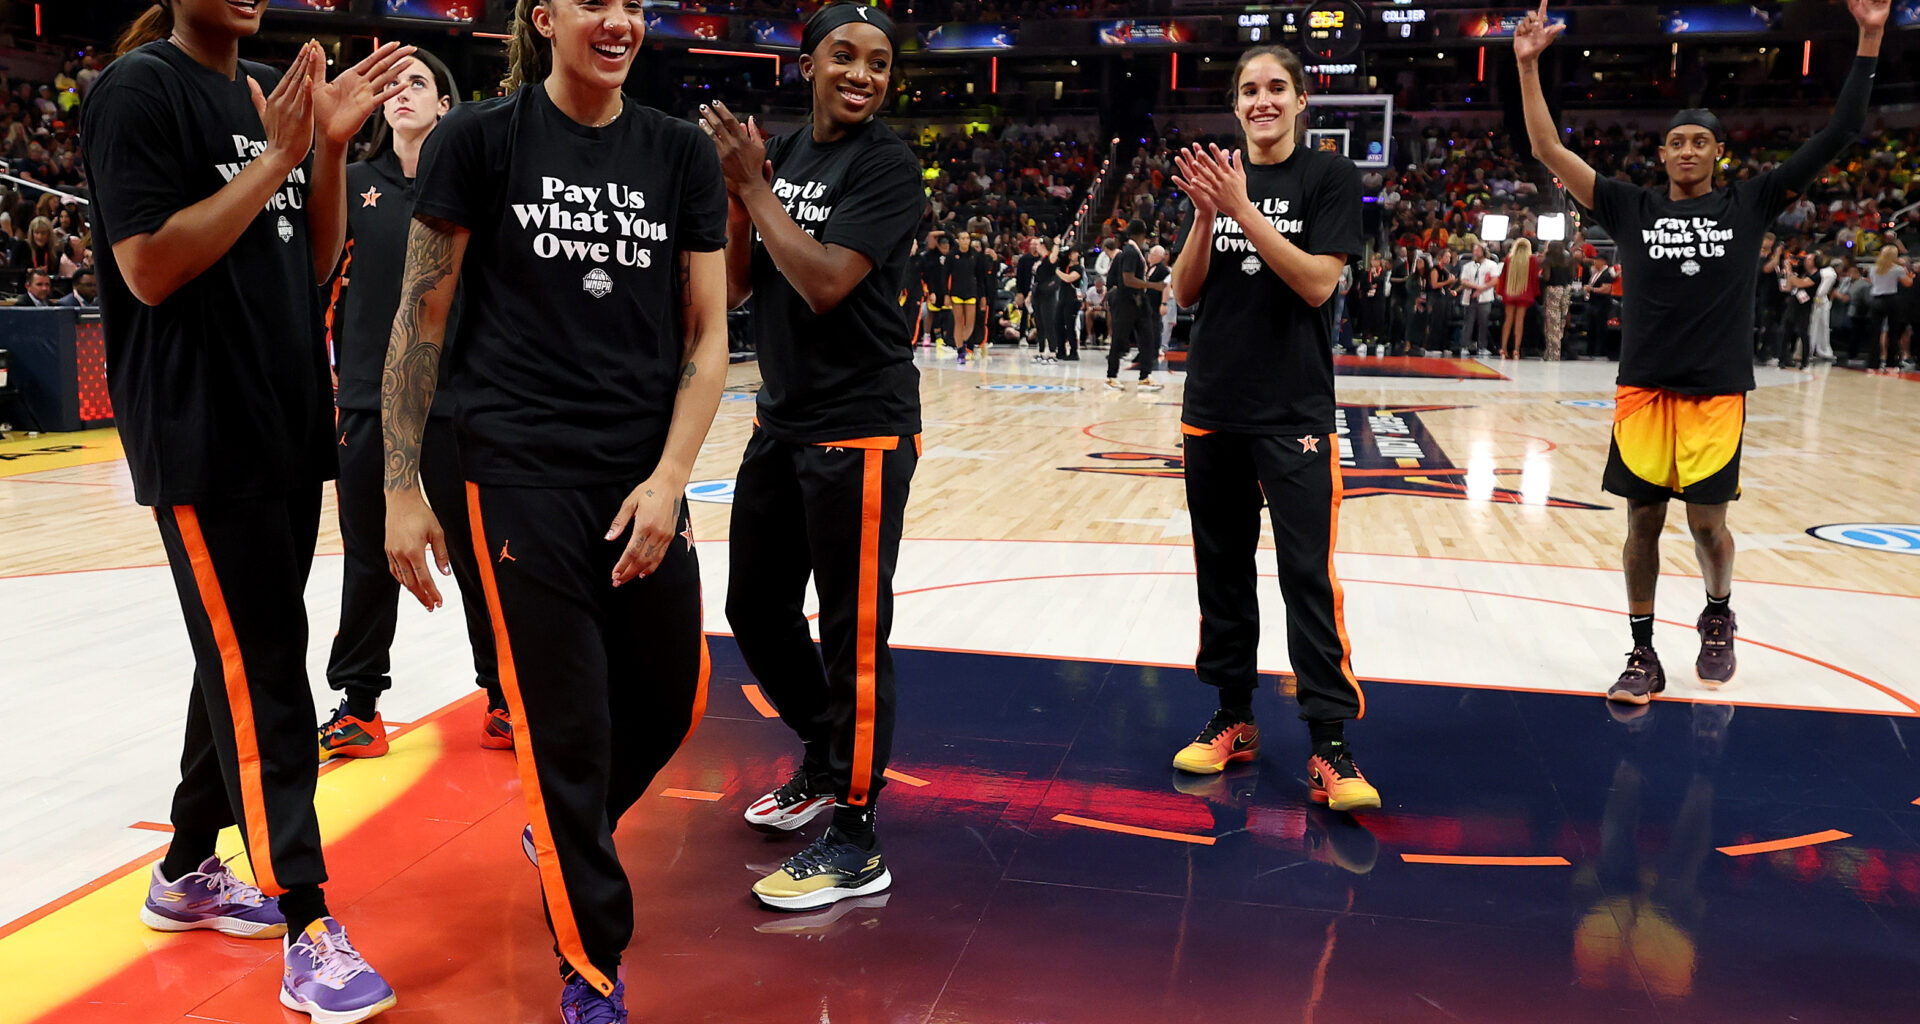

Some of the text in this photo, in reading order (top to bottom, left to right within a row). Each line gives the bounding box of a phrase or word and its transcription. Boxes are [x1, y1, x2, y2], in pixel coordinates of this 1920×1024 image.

[1238, 14, 1269, 27] CLARK
[1382, 10, 1426, 23] COLLIER
[1318, 64, 1357, 74] TISSOT
[541, 176, 645, 212] Pay Us
[772, 177, 828, 204] Pay Us
[795, 201, 832, 222] You
[1262, 197, 1290, 215] Us
[511, 202, 669, 242] What You
[1653, 217, 1690, 234] Pay
[1641, 227, 1734, 245] What You
[533, 232, 651, 269] Owe Us
[1648, 242, 1725, 260] Owe Us
